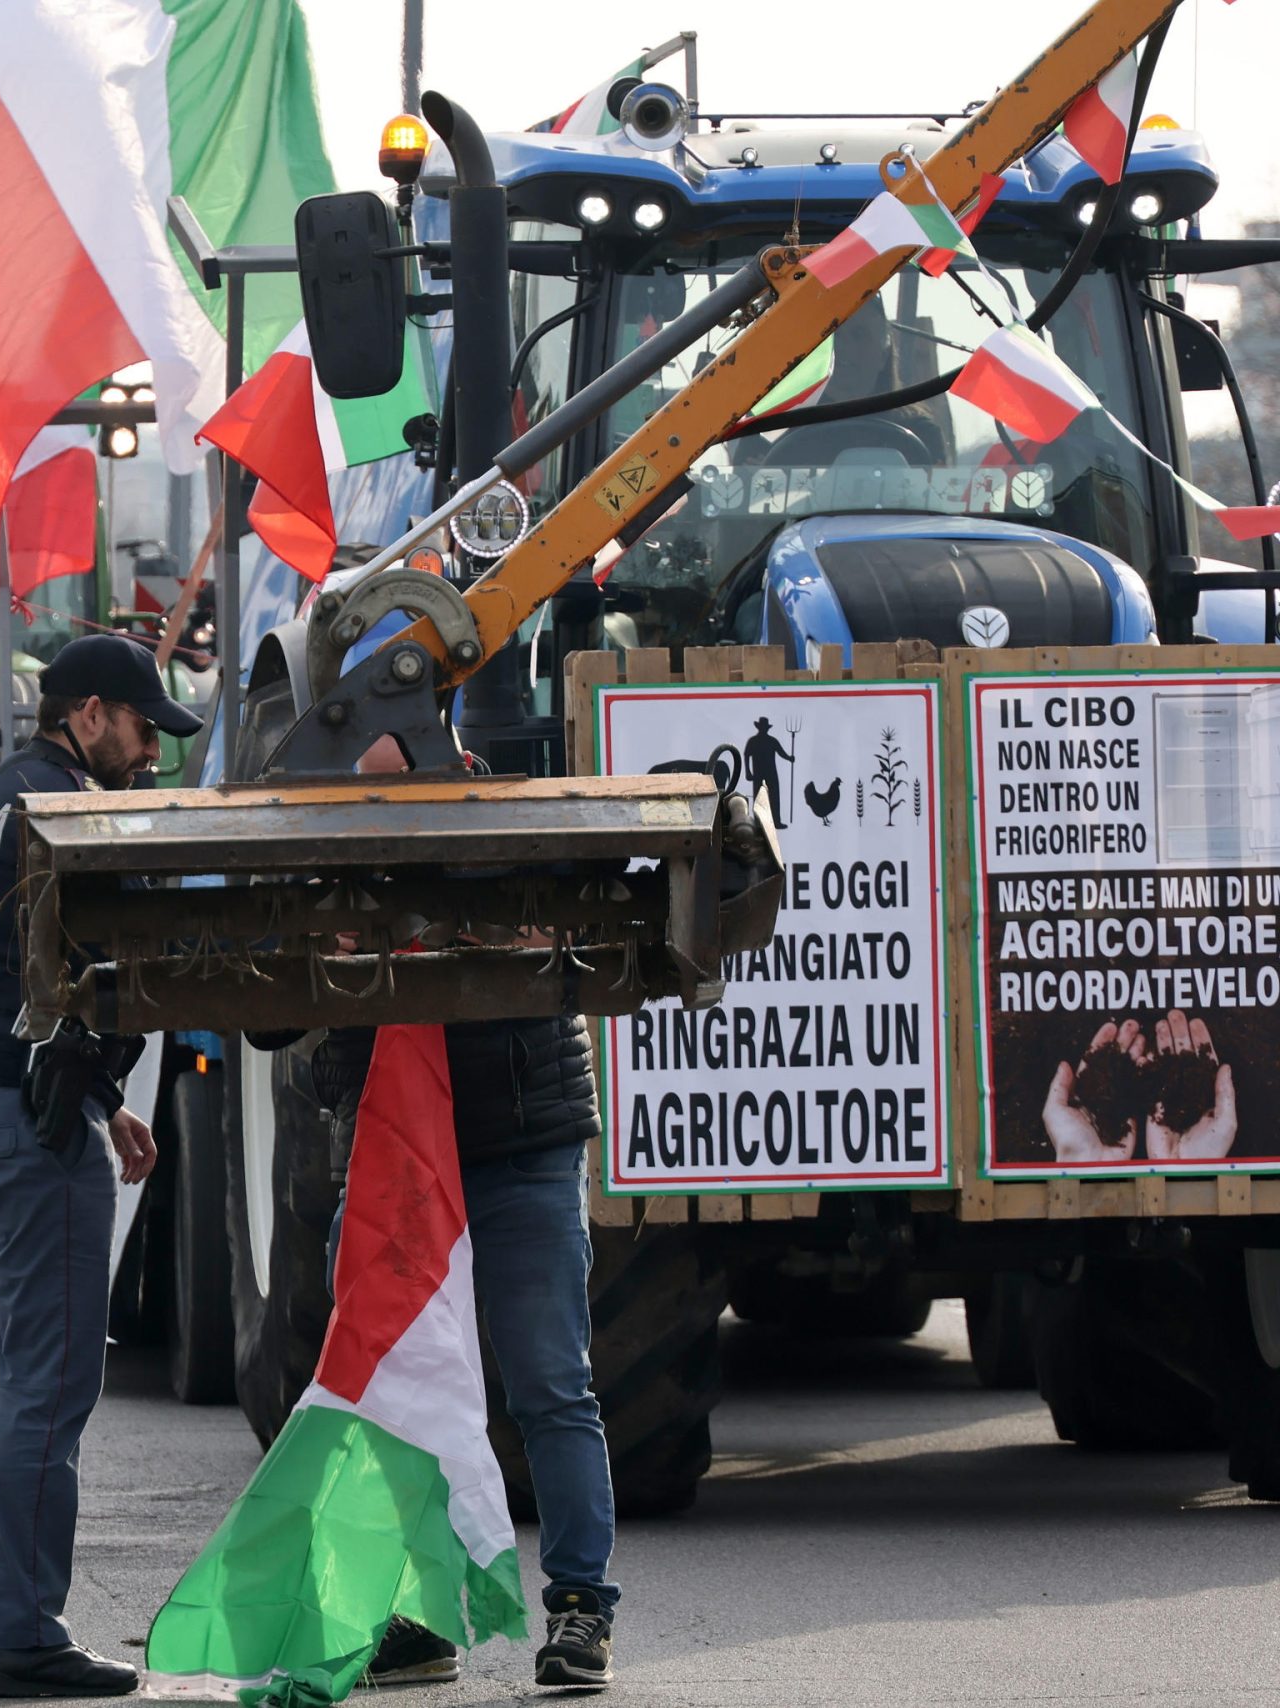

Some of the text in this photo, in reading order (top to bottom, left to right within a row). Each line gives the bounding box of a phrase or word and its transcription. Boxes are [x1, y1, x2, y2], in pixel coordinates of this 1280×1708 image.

[1001, 696, 1135, 728] IL CIBO
[999, 739, 1139, 770] NON NASCE
[1000, 781, 1139, 813] DENTRO UN
[996, 823, 1146, 856] FRIGORIFERO
[821, 860, 909, 910] OGGI
[999, 879, 1076, 912] NASCE
[1082, 878, 1155, 910] DALLE
[1161, 877, 1219, 908] MANI
[1227, 876, 1249, 906] DI
[1000, 915, 1277, 959] AGRICOLTORE
[1001, 966, 1280, 1012] RICORDATEVELO
[631, 1003, 920, 1070] RINGRAZIA UN
[628, 1088, 926, 1168] AGRICOLTORE
